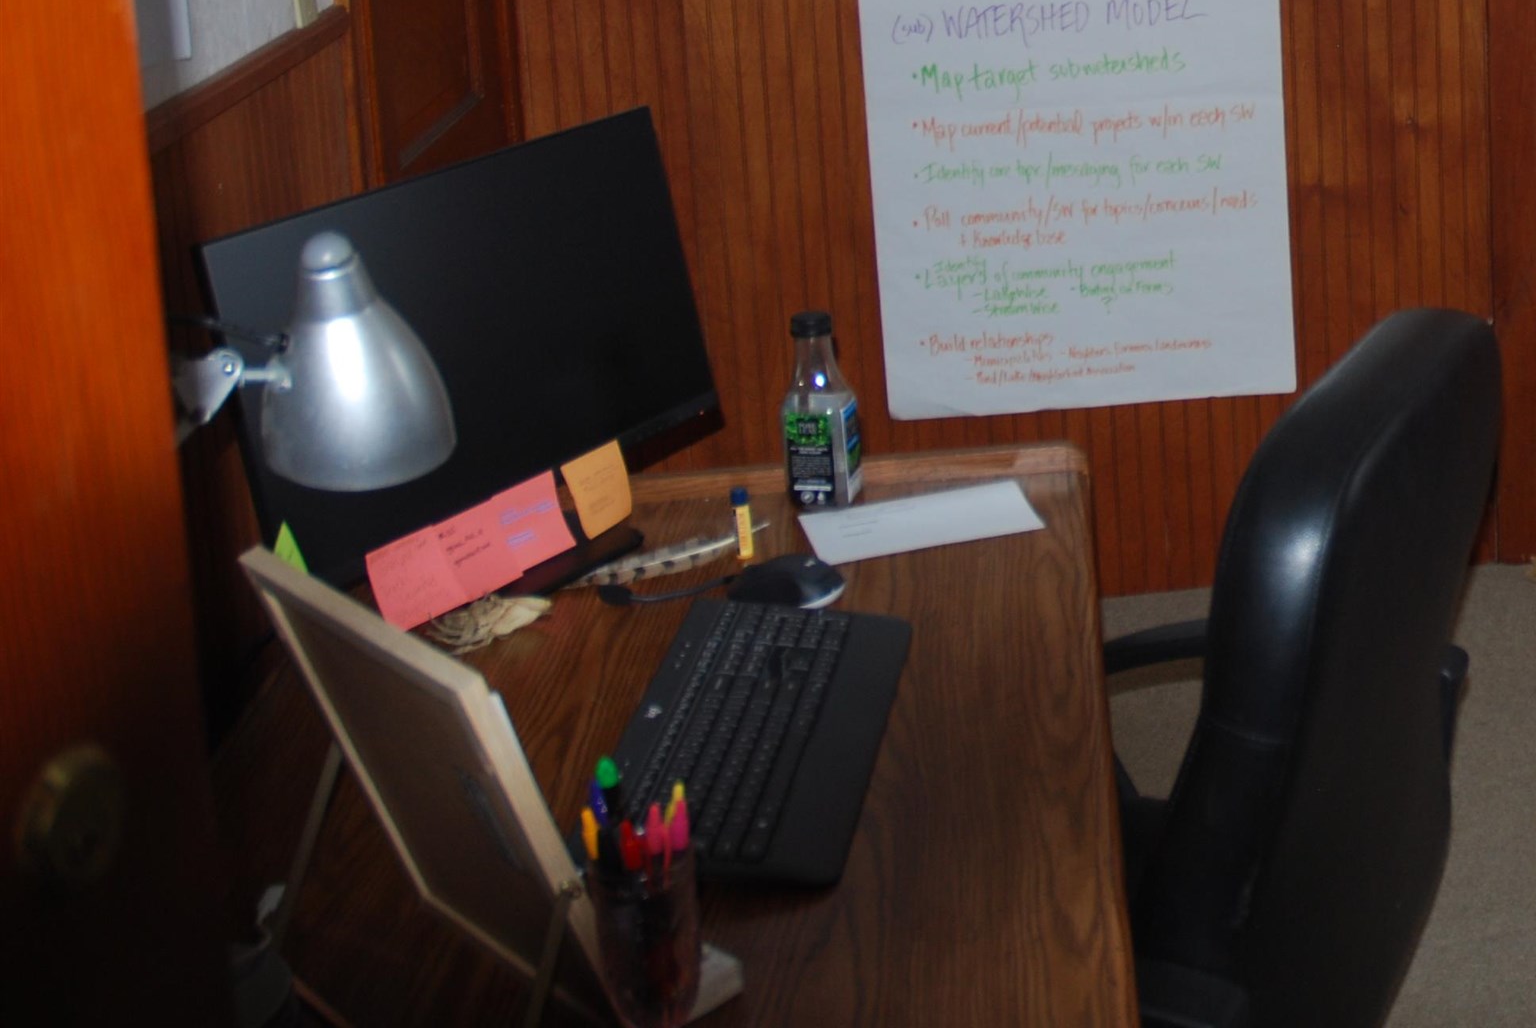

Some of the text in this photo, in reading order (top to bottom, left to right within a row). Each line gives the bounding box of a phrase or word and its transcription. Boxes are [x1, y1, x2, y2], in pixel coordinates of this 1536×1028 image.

[891, 12, 935, 45] (sub)
[942, 0, 1090, 48] WATERSHED
[920, 62, 963, 101] Map
[969, 58, 1038, 102] target
[922, 116, 956, 152] Map
[1091, 110, 1143, 146] projects
[1189, 106, 1226, 132] each
[1231, 103, 1257, 123] SW
[921, 159, 985, 189] Identify
[1129, 154, 1150, 186] for
[1156, 156, 1190, 174] each
[1197, 153, 1222, 173] SW
[1081, 198, 1099, 225] for
[1090, 250, 1175, 288] engagement
[929, 331, 1055, 357] Build relationships
